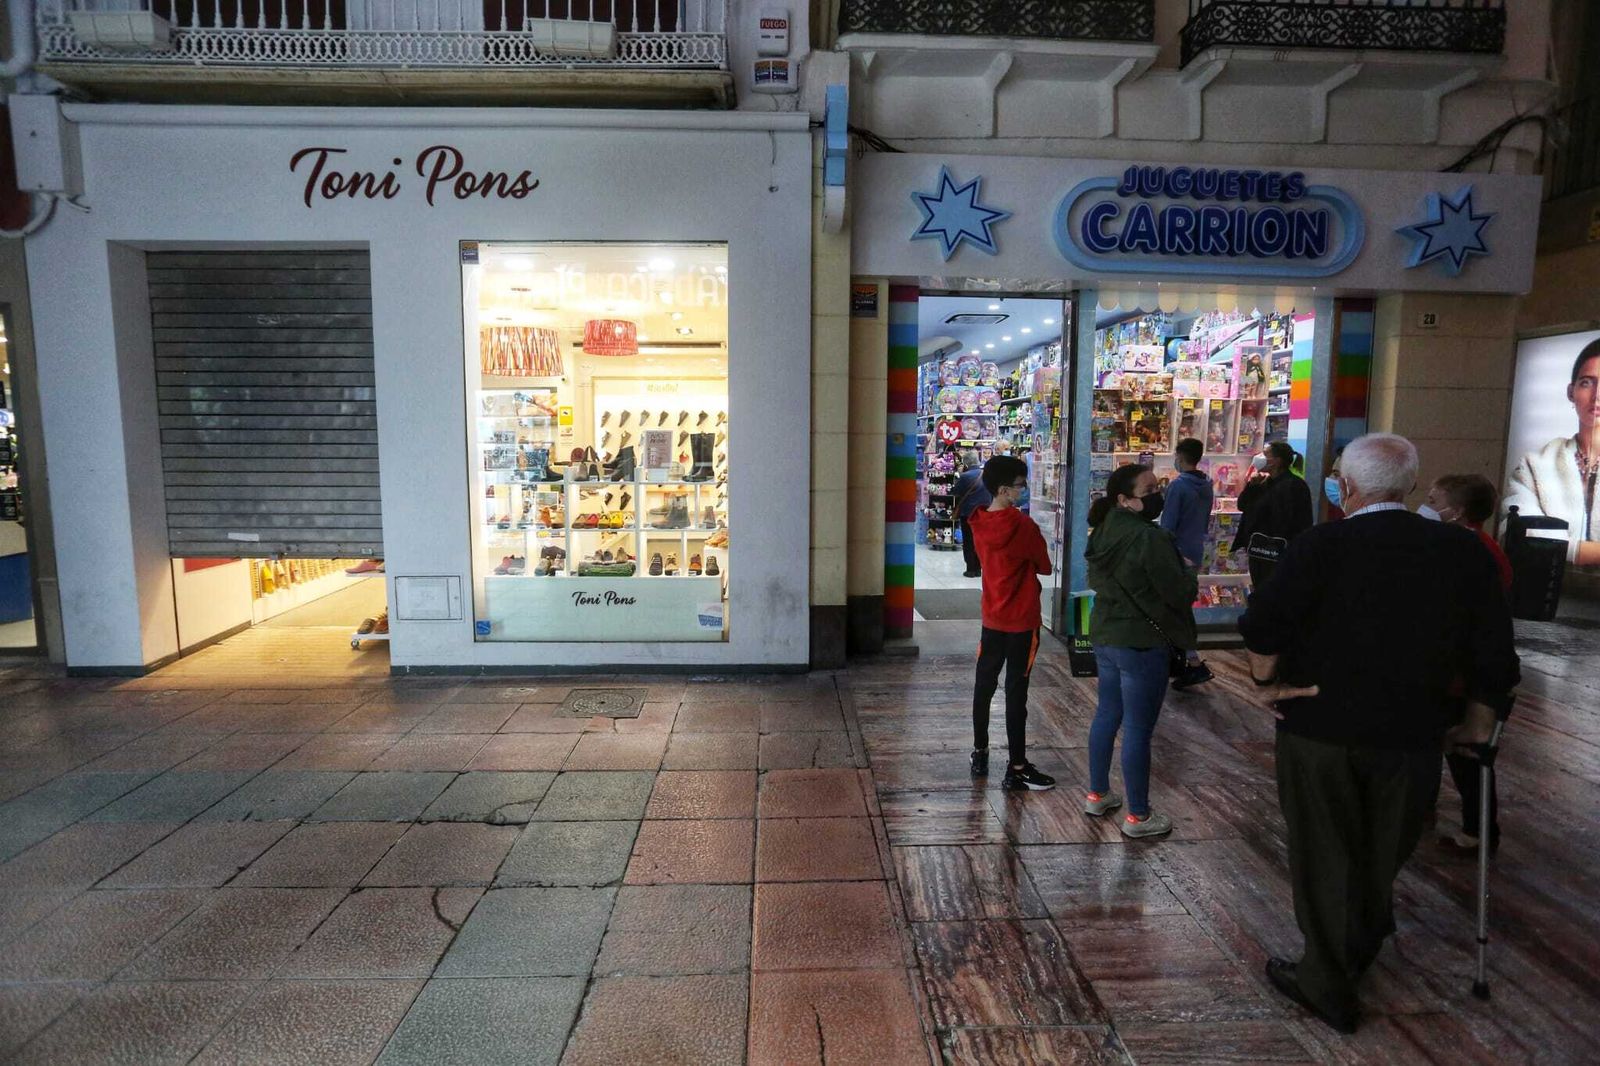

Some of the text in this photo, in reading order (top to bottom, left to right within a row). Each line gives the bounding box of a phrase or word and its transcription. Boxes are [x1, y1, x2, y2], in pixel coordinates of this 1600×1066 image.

[290, 145, 540, 208] Toni Pons
[1118, 165, 1305, 202] JUGUETES
[1082, 200, 1329, 259] CARRION
[939, 421, 960, 441] ty
[571, 590, 637, 607] Toni Pons
